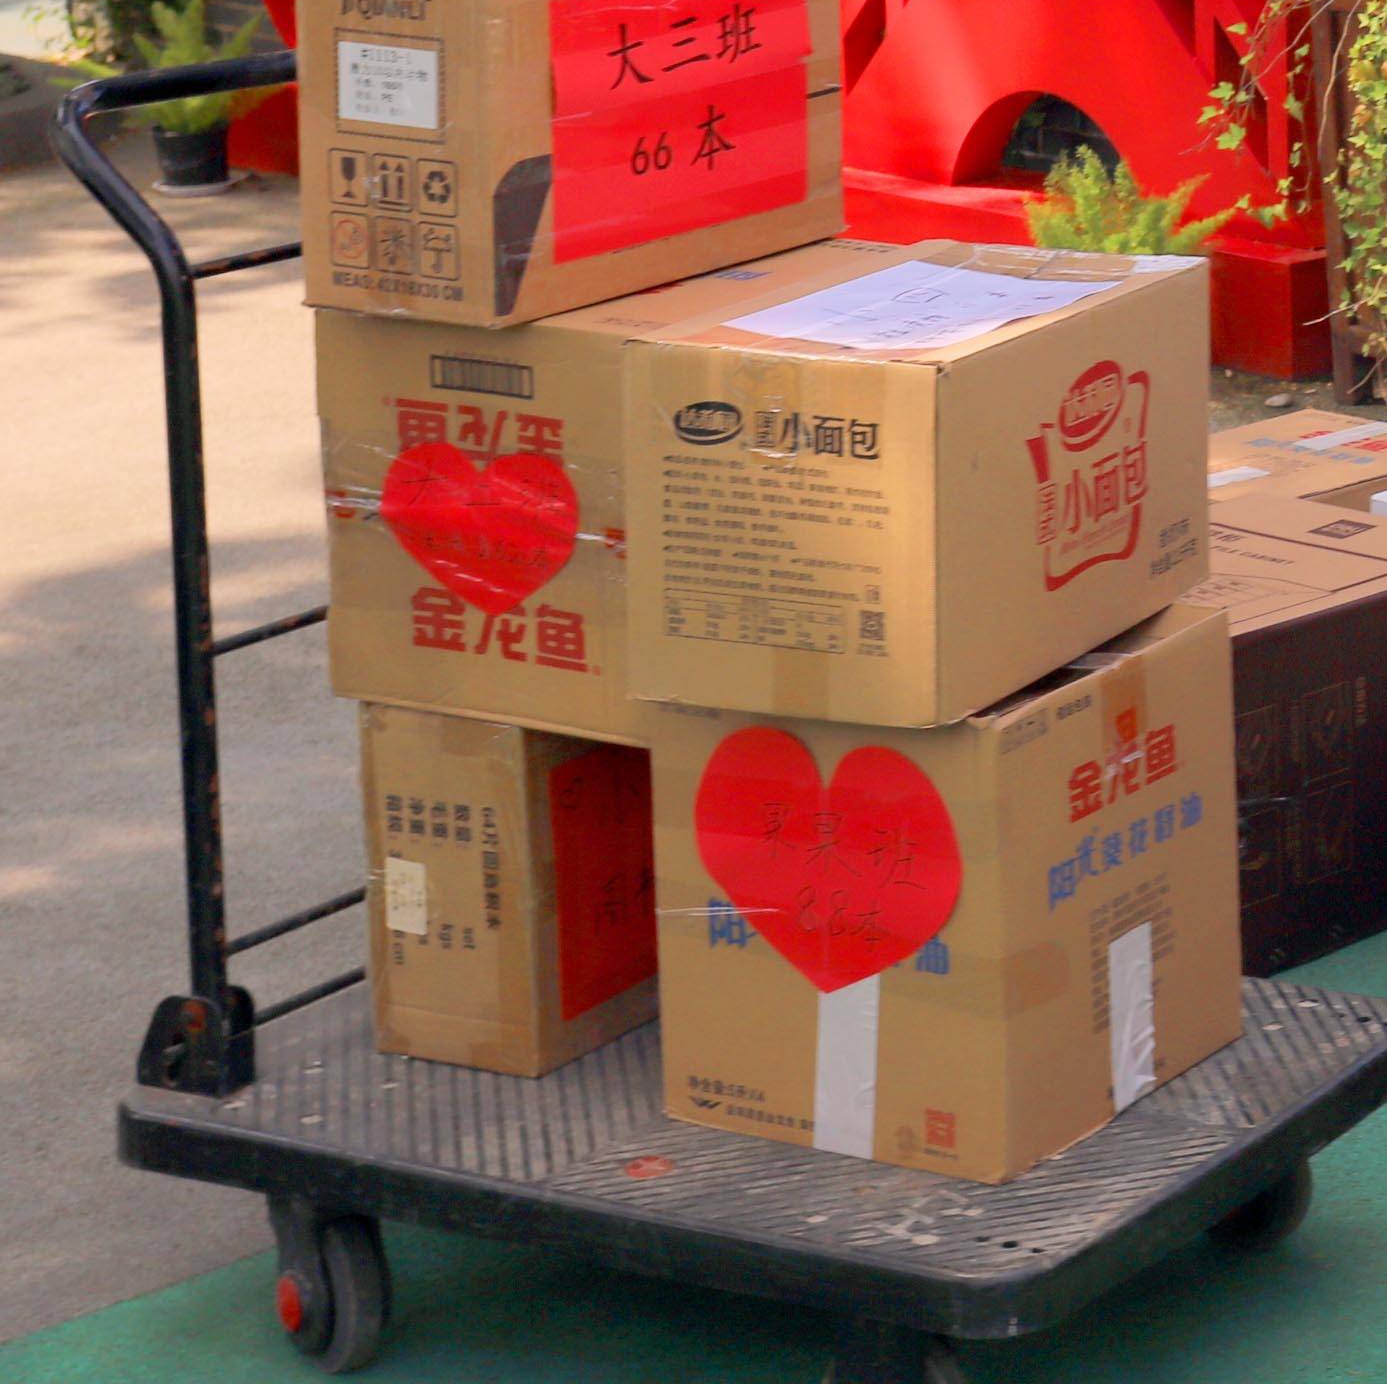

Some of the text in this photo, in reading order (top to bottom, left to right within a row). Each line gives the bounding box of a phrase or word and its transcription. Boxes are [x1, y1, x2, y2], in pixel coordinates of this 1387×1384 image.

[606, 3, 763, 91] 大三班
[631, 104, 737, 176] 66 本
[782, 412, 880, 461] 小面包
[1062, 442, 1148, 534] 小面包
[410, 586, 598, 675] 金龙鱼
